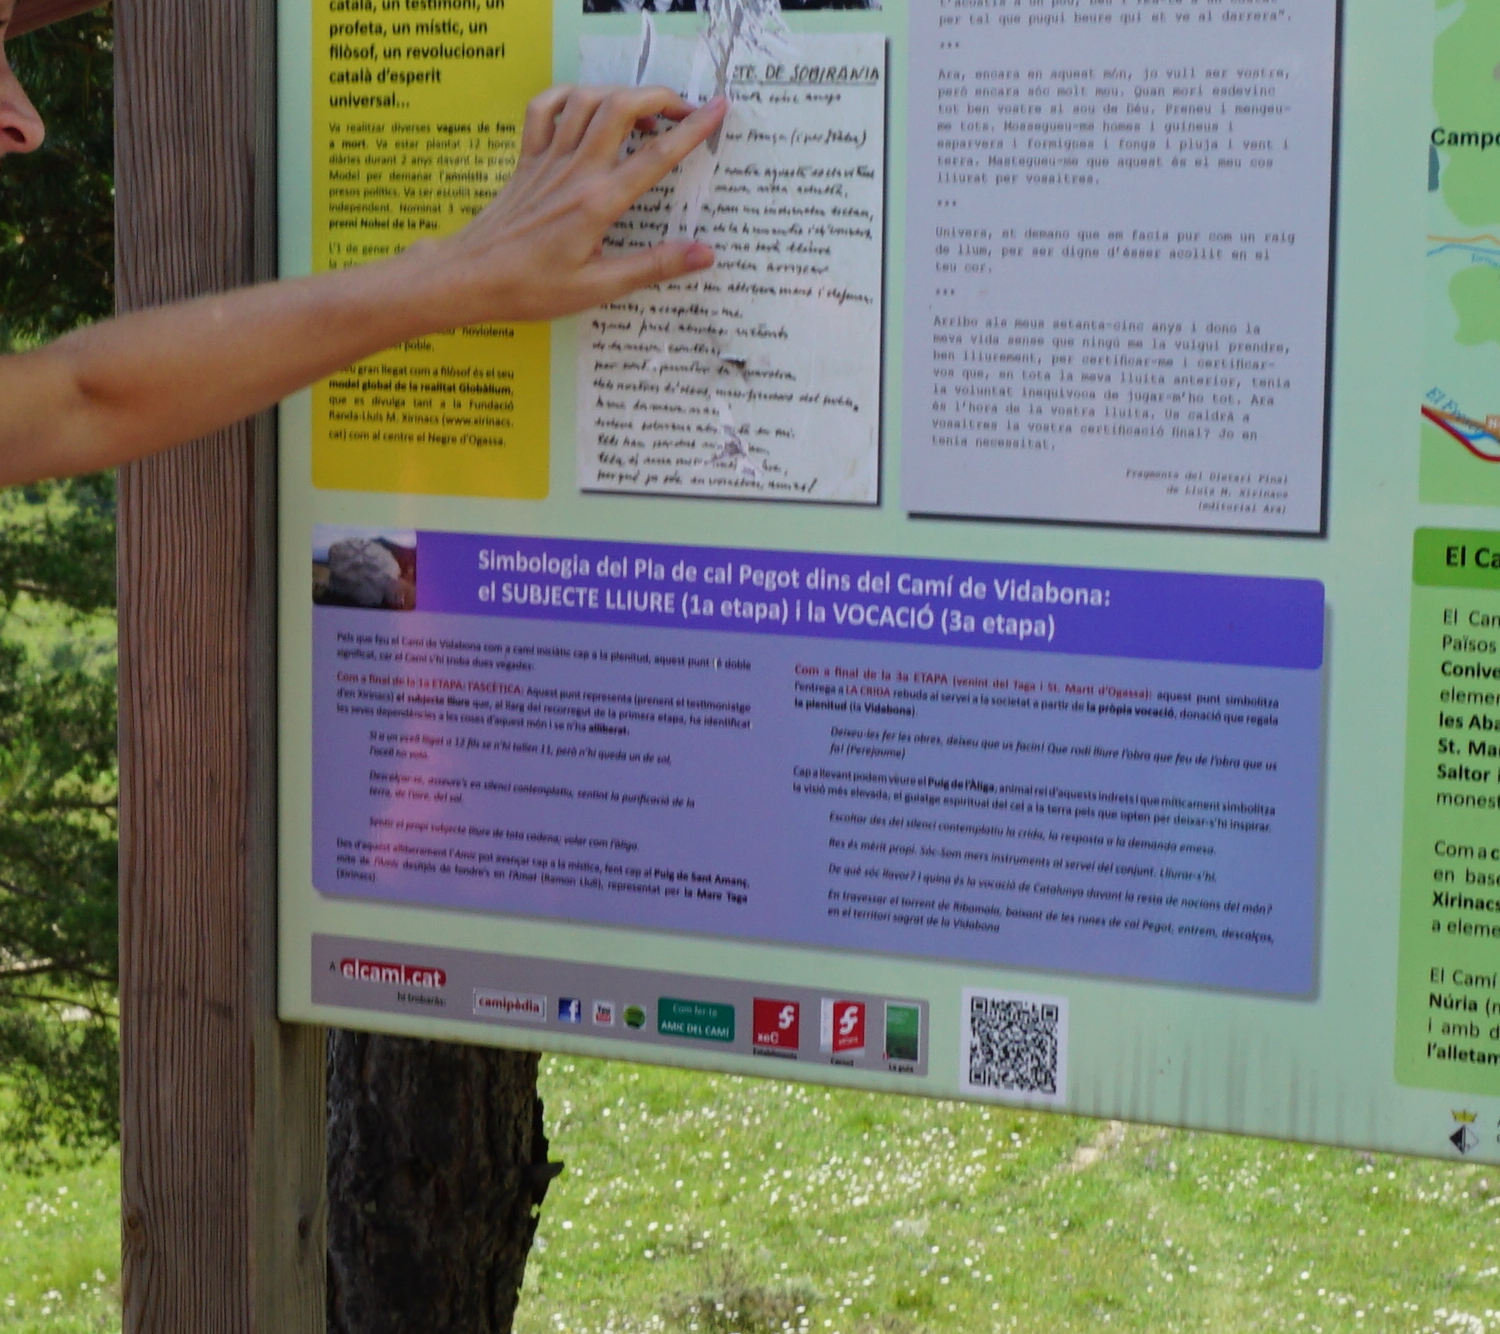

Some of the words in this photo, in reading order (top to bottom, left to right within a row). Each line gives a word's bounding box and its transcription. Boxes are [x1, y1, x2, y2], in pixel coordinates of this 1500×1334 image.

[478, 549, 590, 579] Simbologia
[595, 555, 628, 578] del
[634, 557, 665, 580] Pla
[671, 559, 697, 582] de
[703, 562, 733, 584] cal
[739, 564, 800, 591] Pegot
[805, 567, 851, 591] dins
[856, 570, 891, 593] del
[896, 573, 953, 605] Camí
[958, 575, 987, 599] de
[993, 578, 1110, 606] Vidabona:
[1445, 545, 1467, 567] El
[477, 580, 496, 602] el
[501, 582, 599, 608] SUBJECTE
[605, 588, 675, 613] LLIURE
[681, 591, 714, 619] (1a
[719, 597, 789, 624] etapa)
[807, 599, 826, 623] la
[832, 602, 935, 629] VOCACIÓ
[940, 607, 975, 635] (3a
[981, 613, 1055, 641] etapa)
